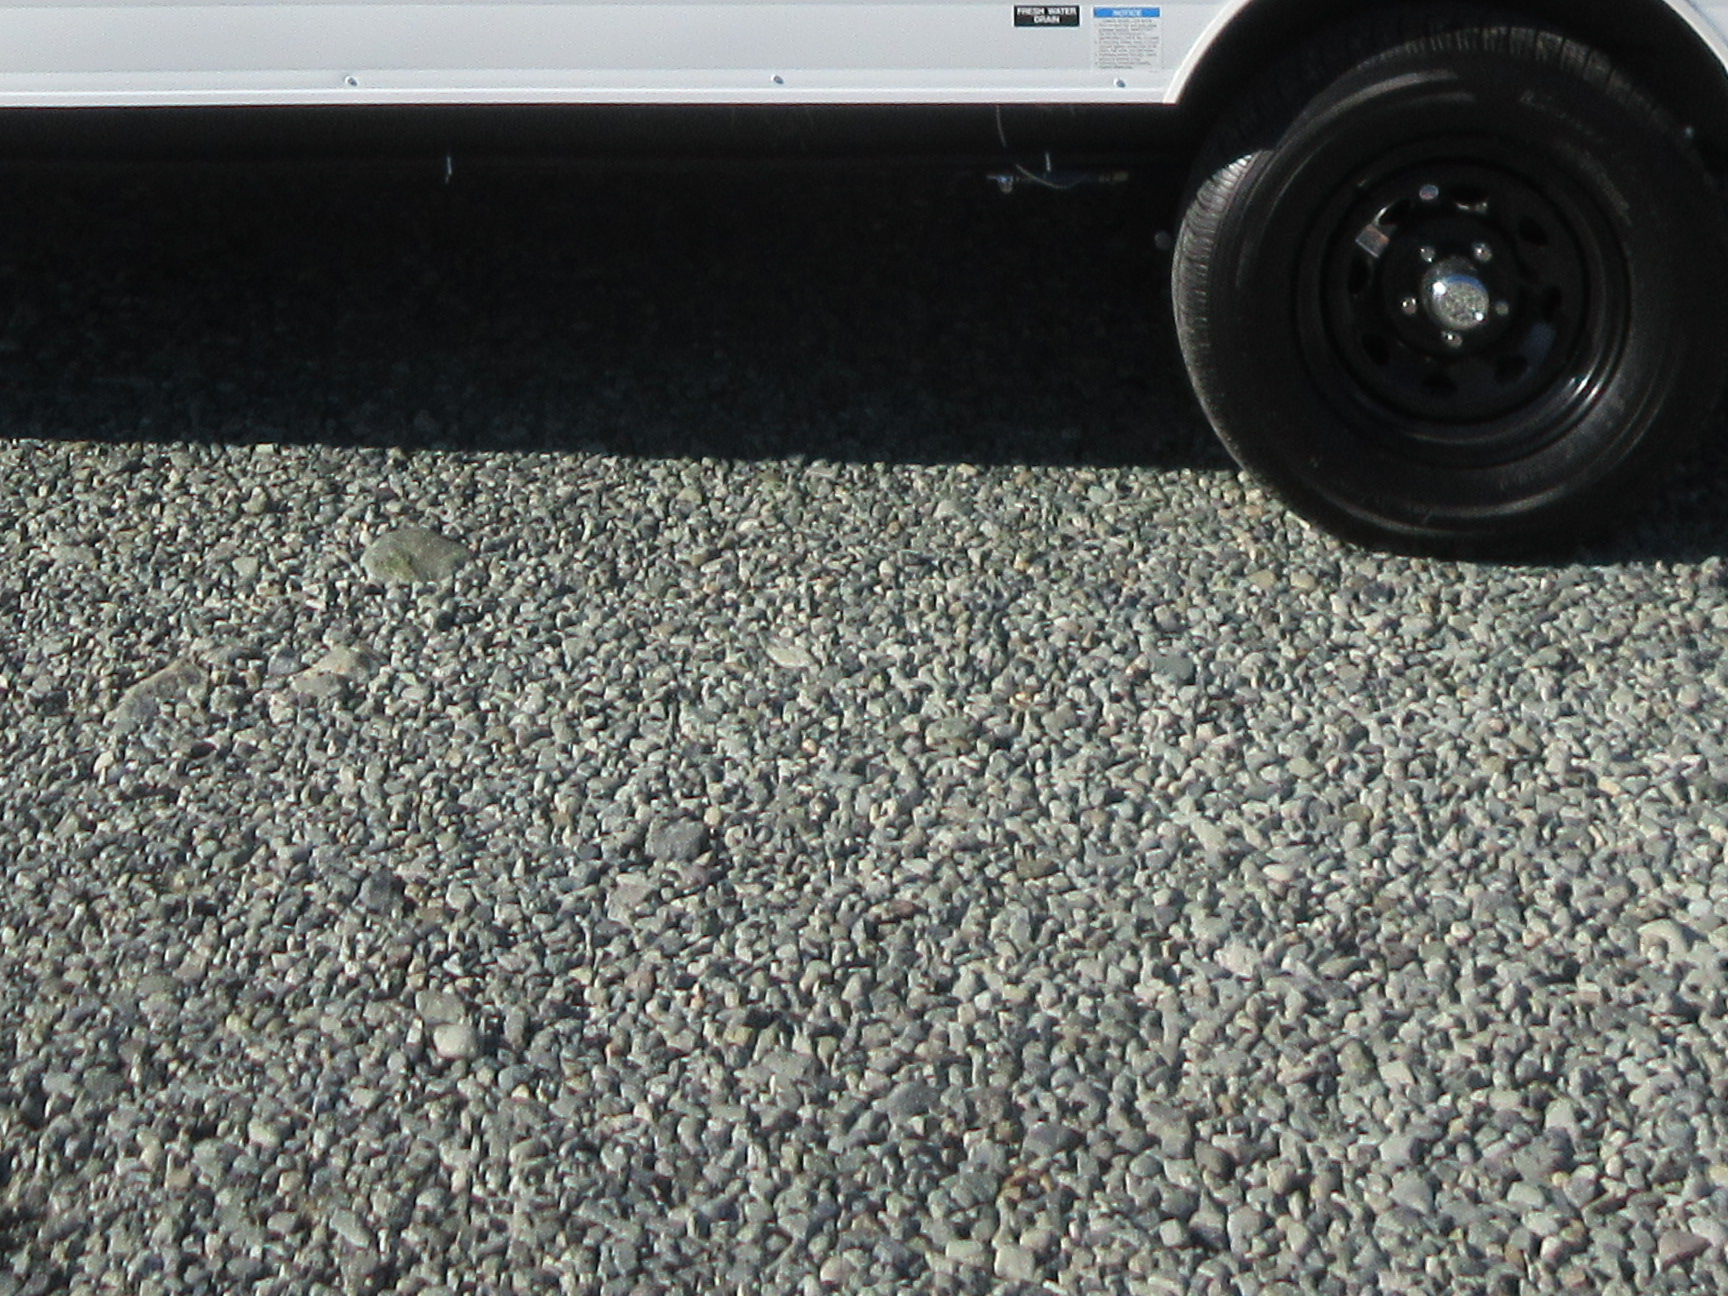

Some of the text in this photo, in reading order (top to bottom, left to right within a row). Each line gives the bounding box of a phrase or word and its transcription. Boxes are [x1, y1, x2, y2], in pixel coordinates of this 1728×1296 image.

[1016, 7, 1077, 16] FRESH WATER
[1033, 16, 1061, 24] DRAIN
